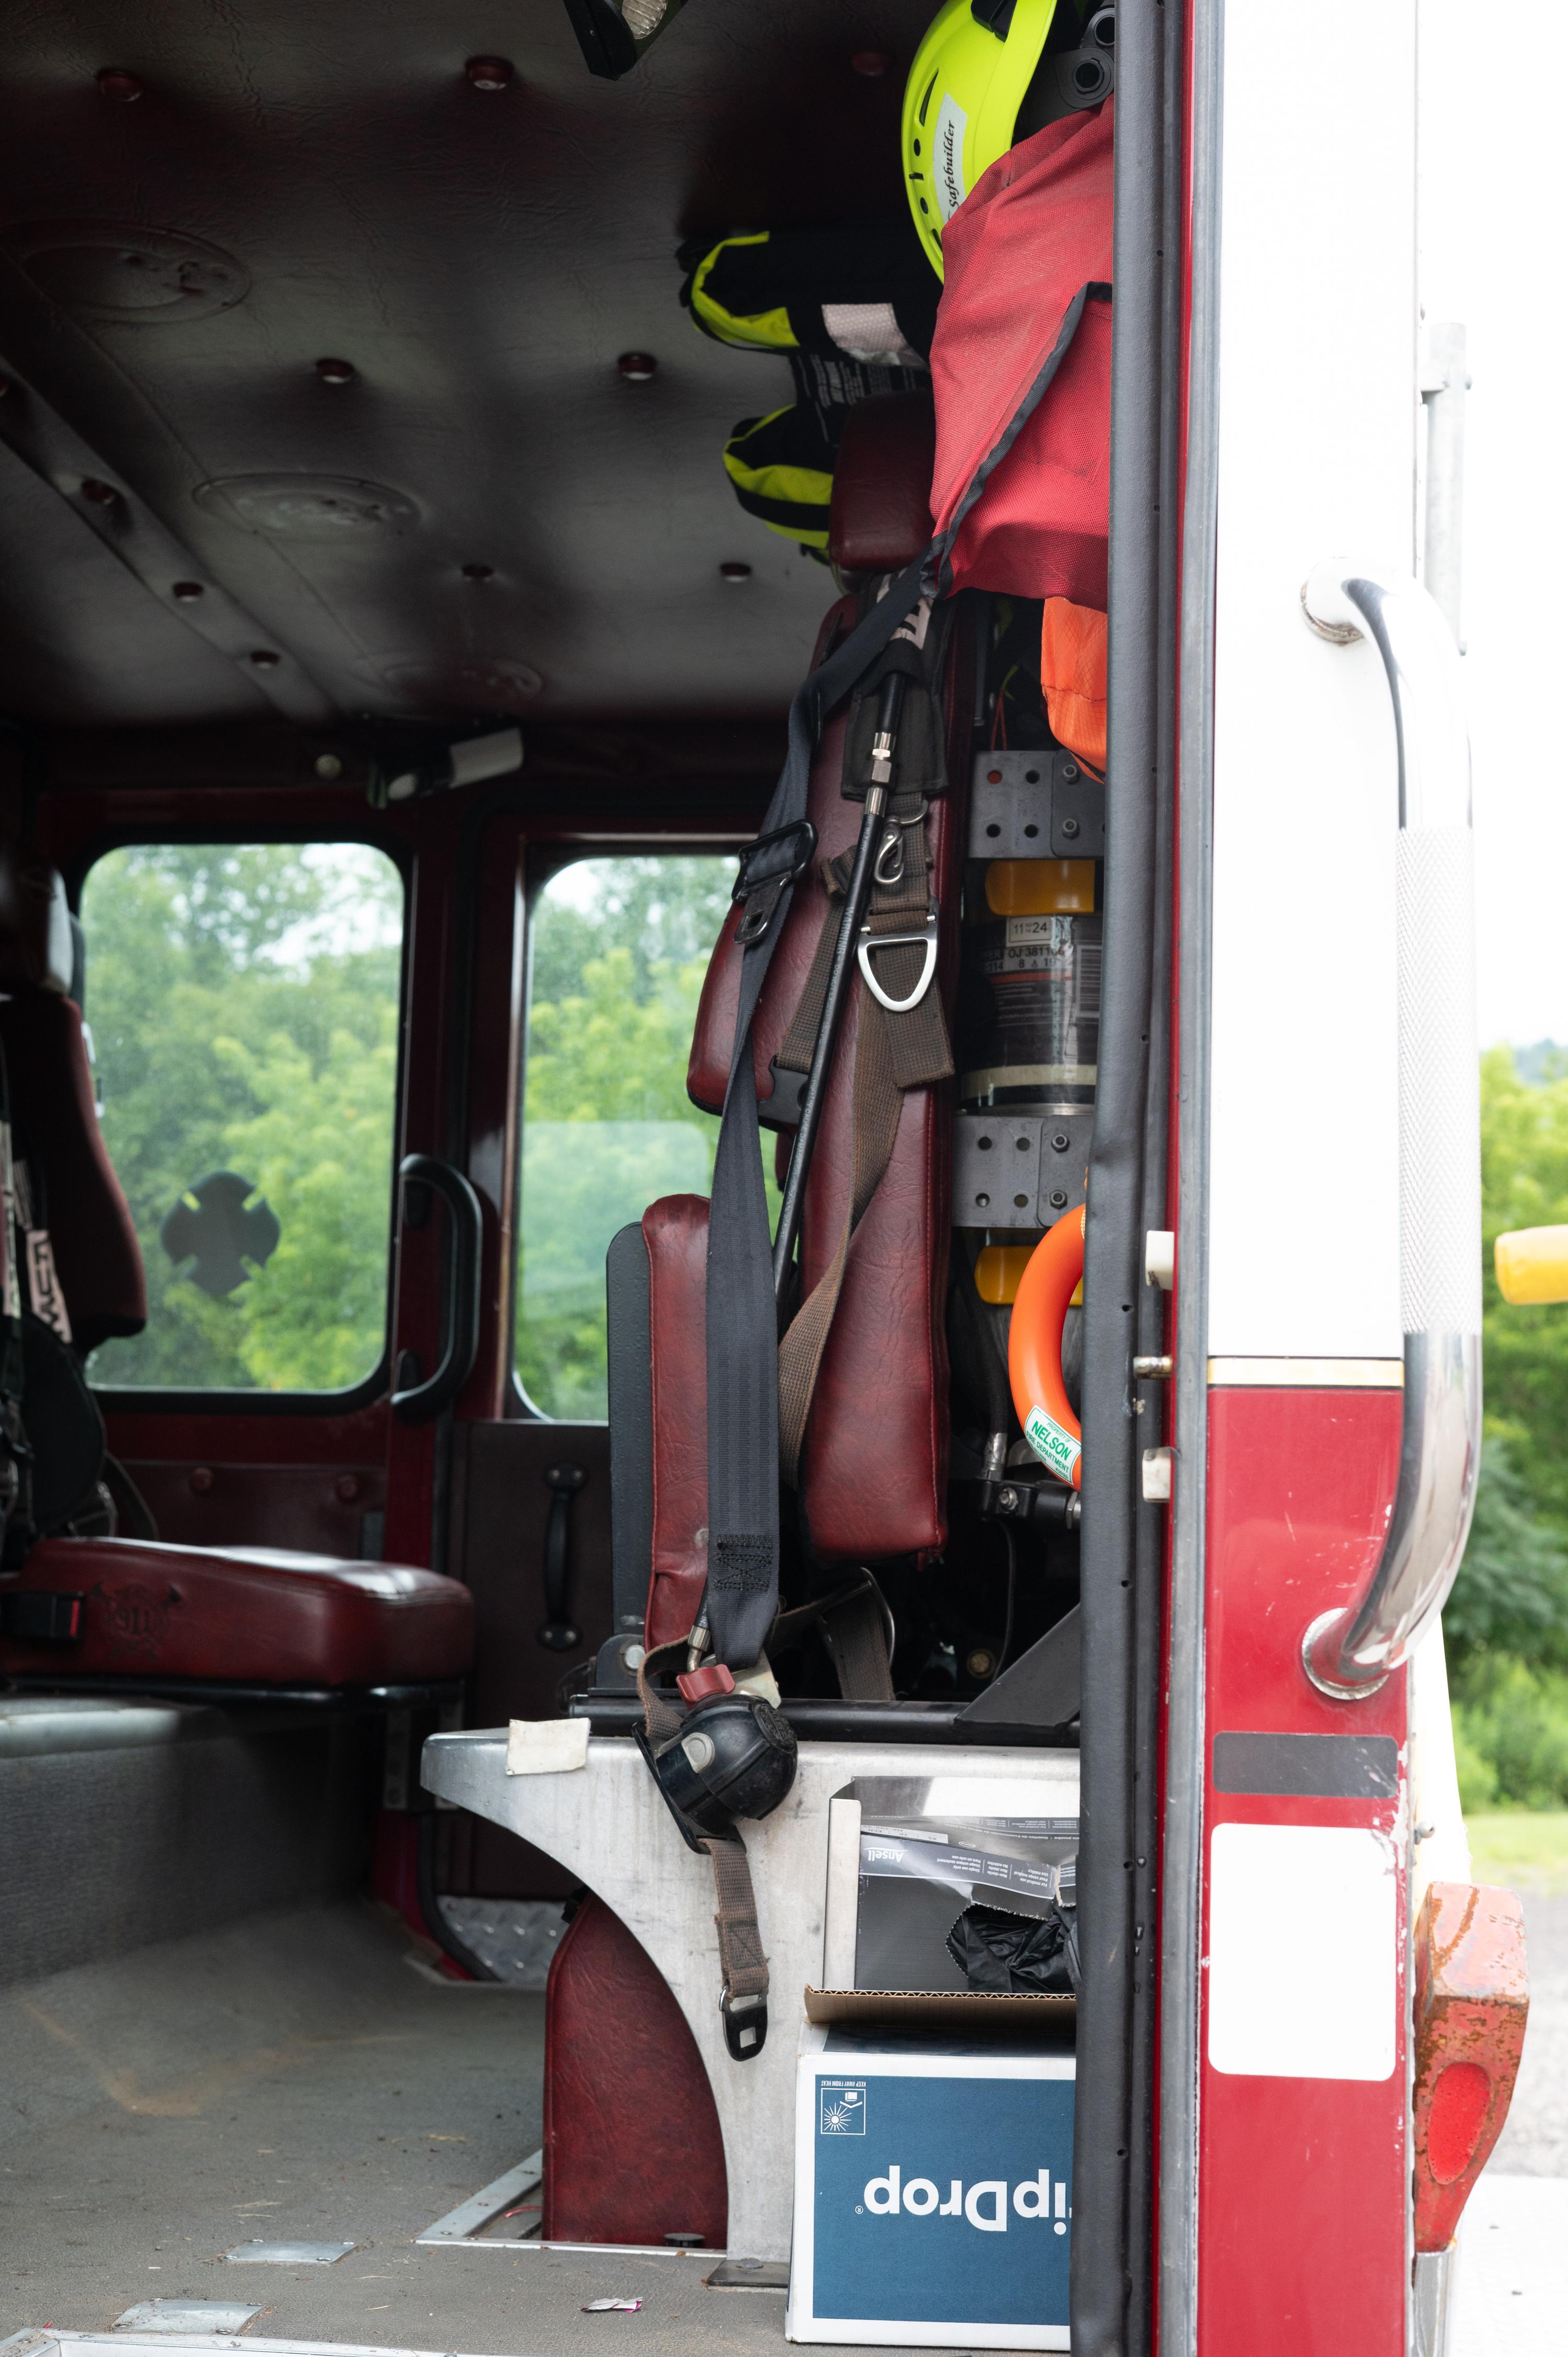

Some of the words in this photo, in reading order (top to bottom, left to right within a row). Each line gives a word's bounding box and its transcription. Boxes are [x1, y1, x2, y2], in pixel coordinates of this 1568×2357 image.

[944, 120, 959, 207] Safebuilder
[836, 905, 855, 955] WARNING
[1033, 922, 1047, 933] 24
[1032, 1421, 1071, 1461] NELSON
[1047, 1422, 1065, 1439] PROPERTY
[1026, 1431, 1036, 1444] FIRE
[1036, 1442, 1069, 1473] DEPARTMENT
[868, 1850, 904, 1862] Ansell
[864, 2165, 1071, 2235] ipDrop
